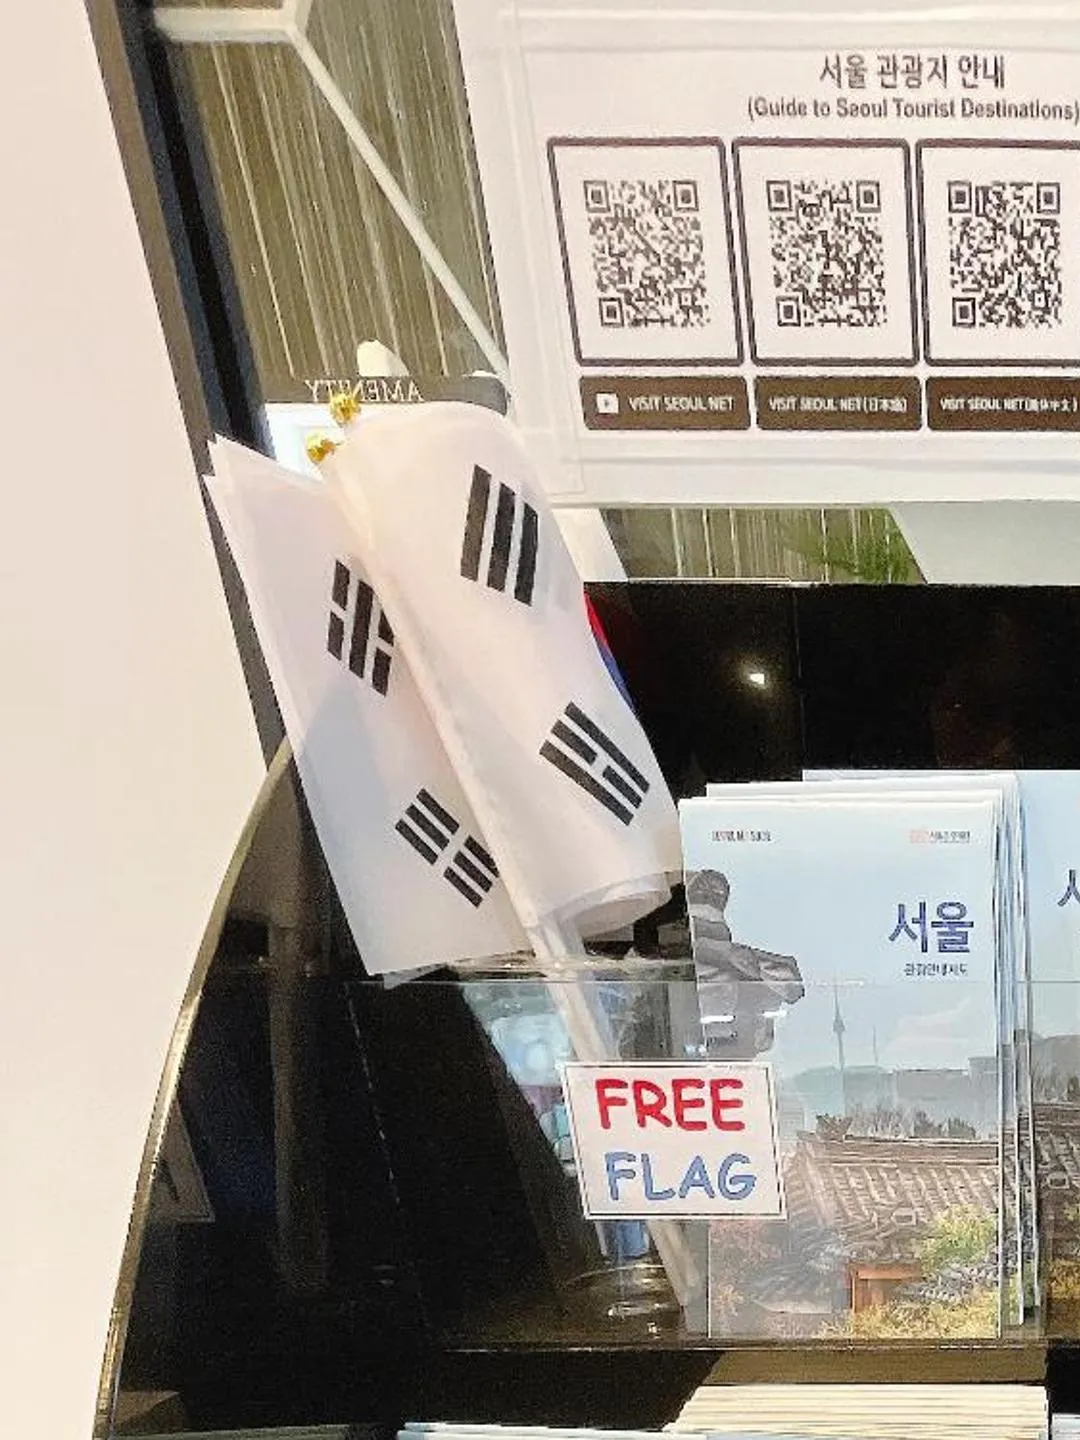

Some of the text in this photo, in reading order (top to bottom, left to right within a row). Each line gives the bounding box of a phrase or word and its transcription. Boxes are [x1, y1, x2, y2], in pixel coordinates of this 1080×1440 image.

[819, 54, 1005, 89] 서울 관광지 안내
[747, 96, 1080, 126] (Guide to Seoul Tourist Destinations)
[628, 395, 734, 411] VISIT SEOUL NET
[769, 398, 797, 411] VISIT
[799, 398, 838, 411] SEOUL
[940, 398, 965, 411] VISIT
[967, 398, 1002, 411] SEOUL
[888, 901, 974, 953] 서울
[594, 1078, 746, 1132] FREE
[604, 1151, 758, 1201] FLAG
